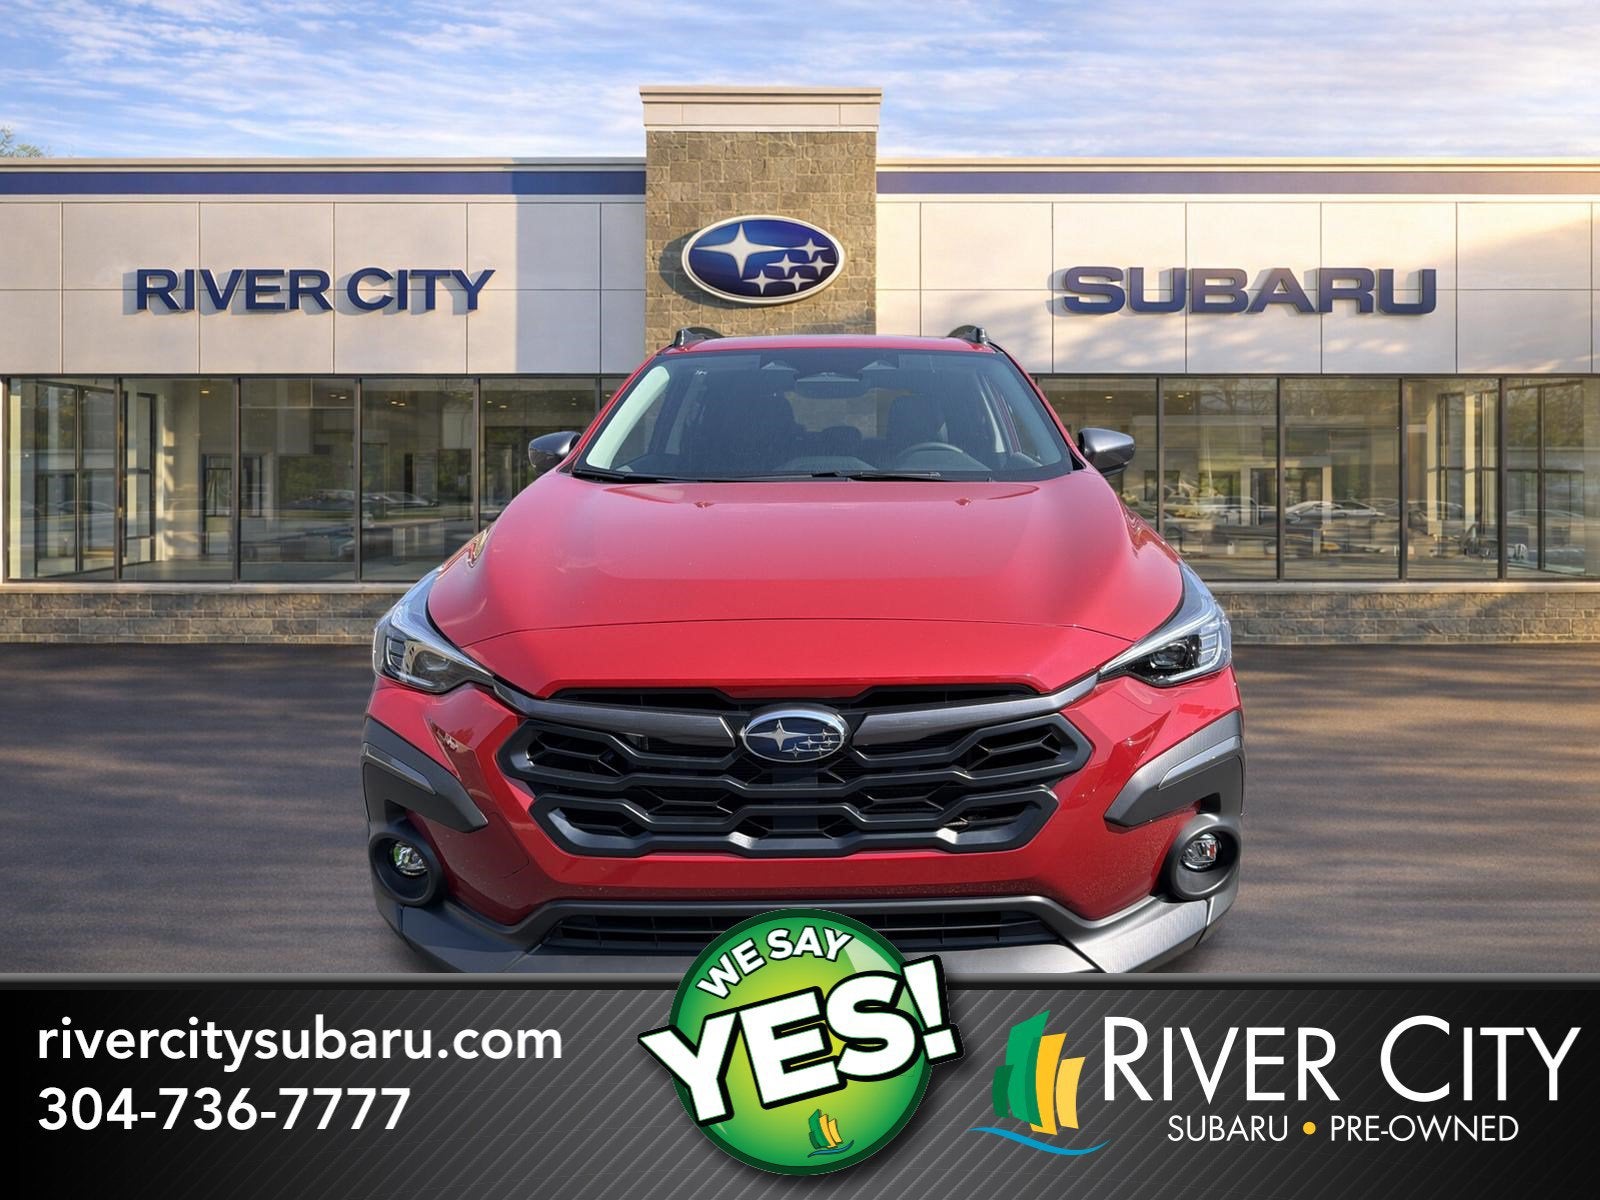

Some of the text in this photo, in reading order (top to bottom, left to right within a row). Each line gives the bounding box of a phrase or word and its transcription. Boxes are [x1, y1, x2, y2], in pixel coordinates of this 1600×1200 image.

[135, 266, 497, 312] RIVER CITY
[1062, 266, 1437, 315] SUBARU
